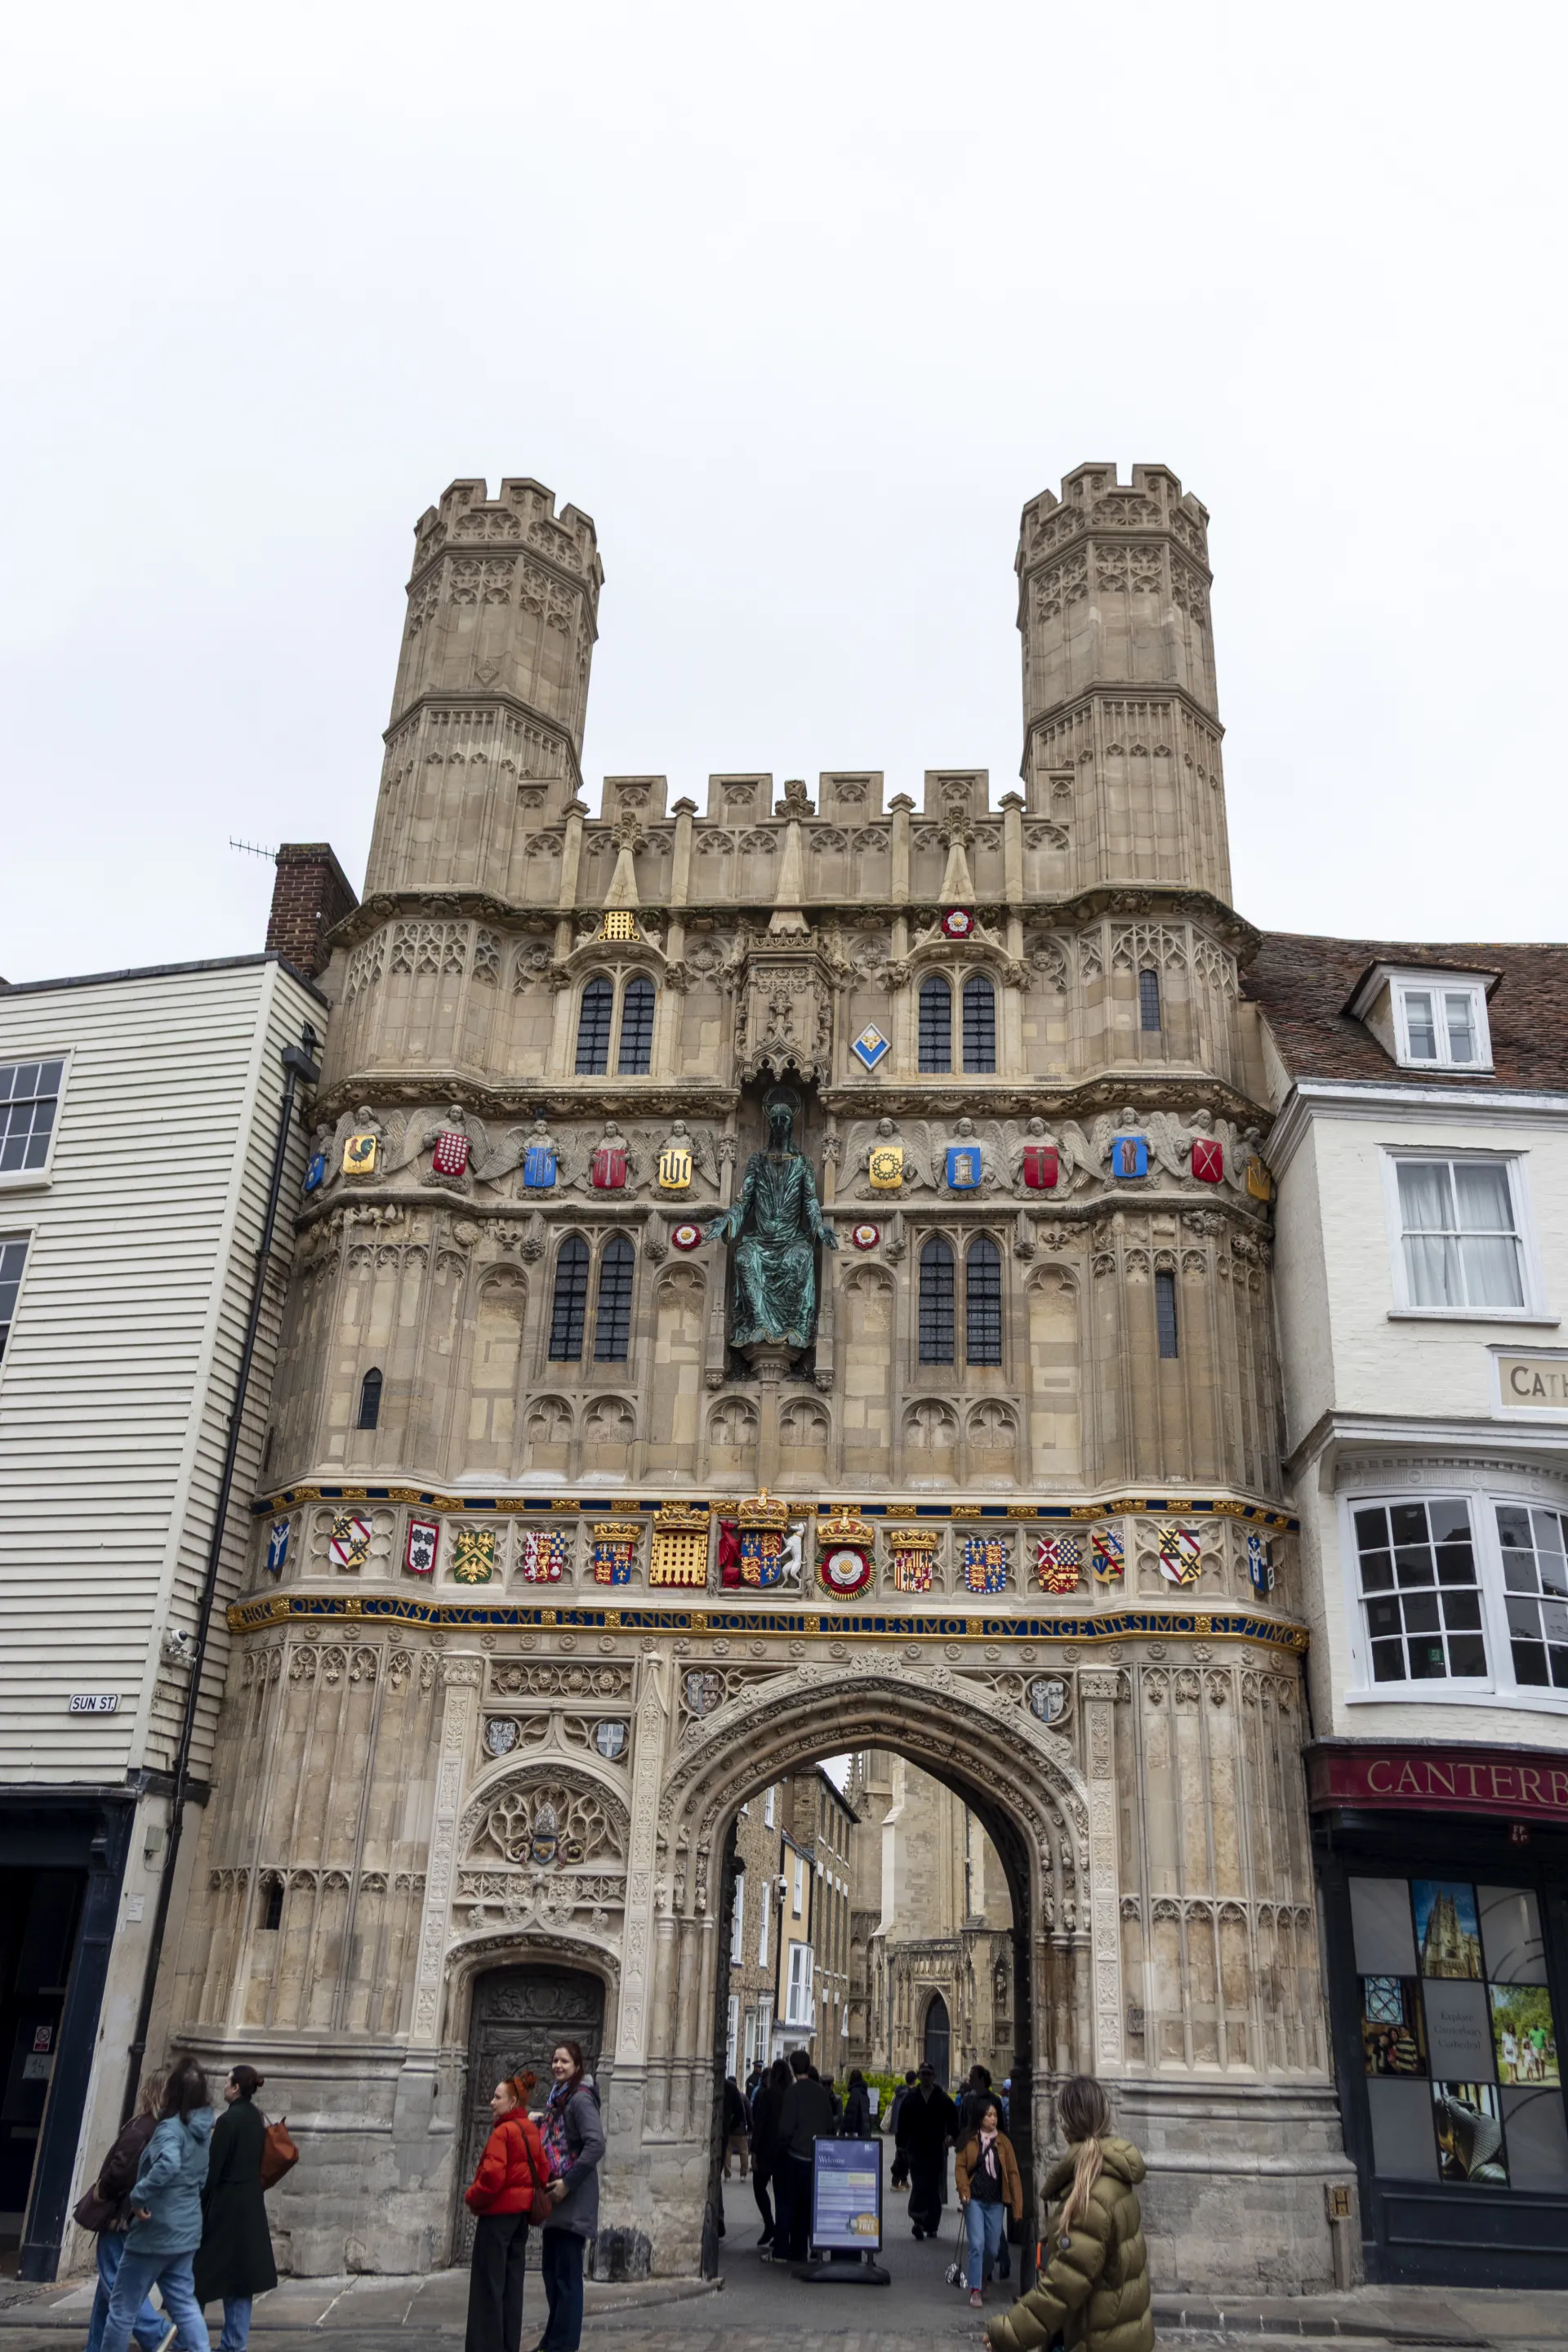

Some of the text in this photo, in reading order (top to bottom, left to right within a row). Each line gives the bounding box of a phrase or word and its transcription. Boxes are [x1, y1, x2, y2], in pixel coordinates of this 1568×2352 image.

[245, 1598, 1295, 1644] HOC OPVS CONSTRVCTVM EST ANNO DOMINI MILLESIMO QVINGENTESIMO SEPTIMO
[73, 1697, 114, 1709] SUN ST.
[1367, 1761, 1568, 1806] CANTERB
[1441, 2011, 1474, 2022] Explore
[1434, 2025, 1481, 2038] Canterbury
[1438, 2039, 1481, 2050] Cathedral
[818, 2156, 845, 2164] Welcome
[1334, 2191, 1349, 2215] H
